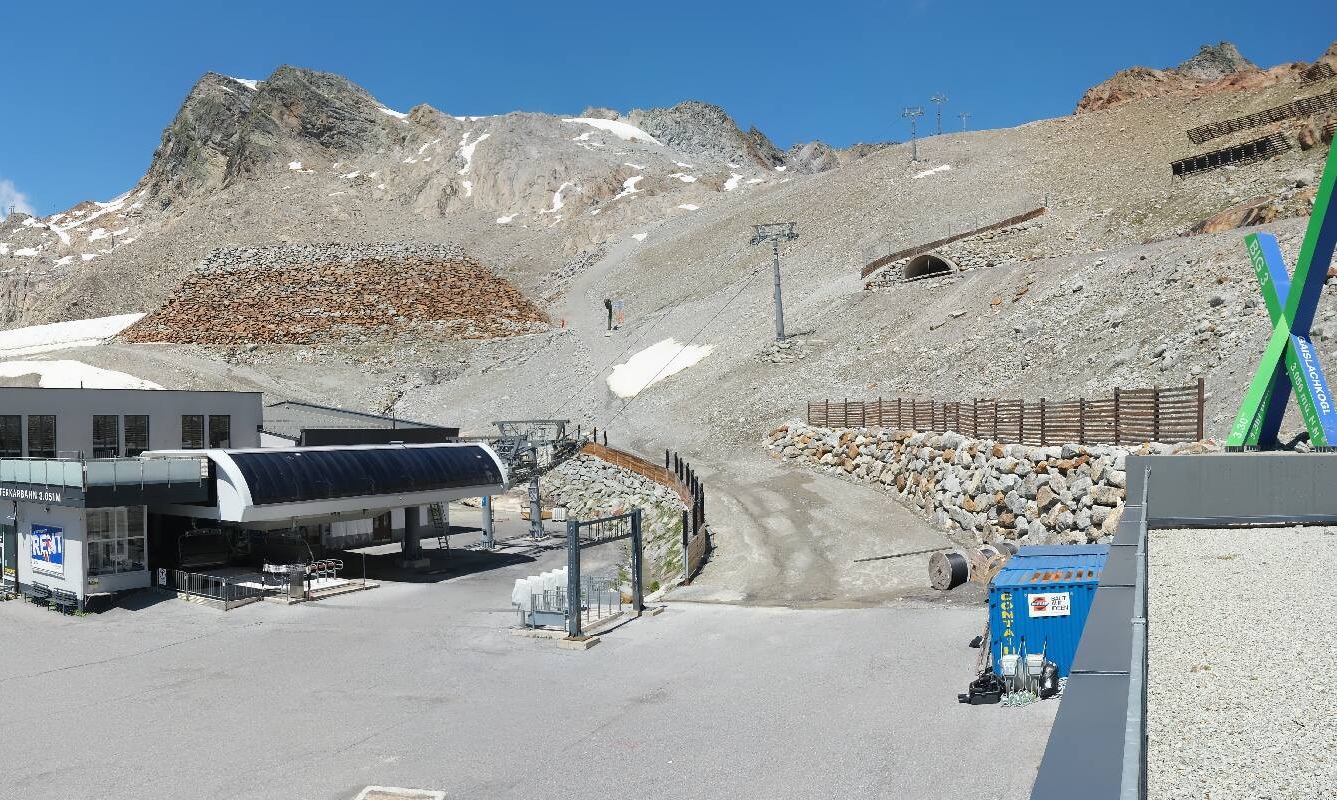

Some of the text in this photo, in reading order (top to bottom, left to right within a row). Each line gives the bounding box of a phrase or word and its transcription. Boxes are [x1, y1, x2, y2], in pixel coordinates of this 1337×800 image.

[1250, 238, 1269, 286] BIG 3
[1297, 335, 1331, 416] GAISLACHKOGL
